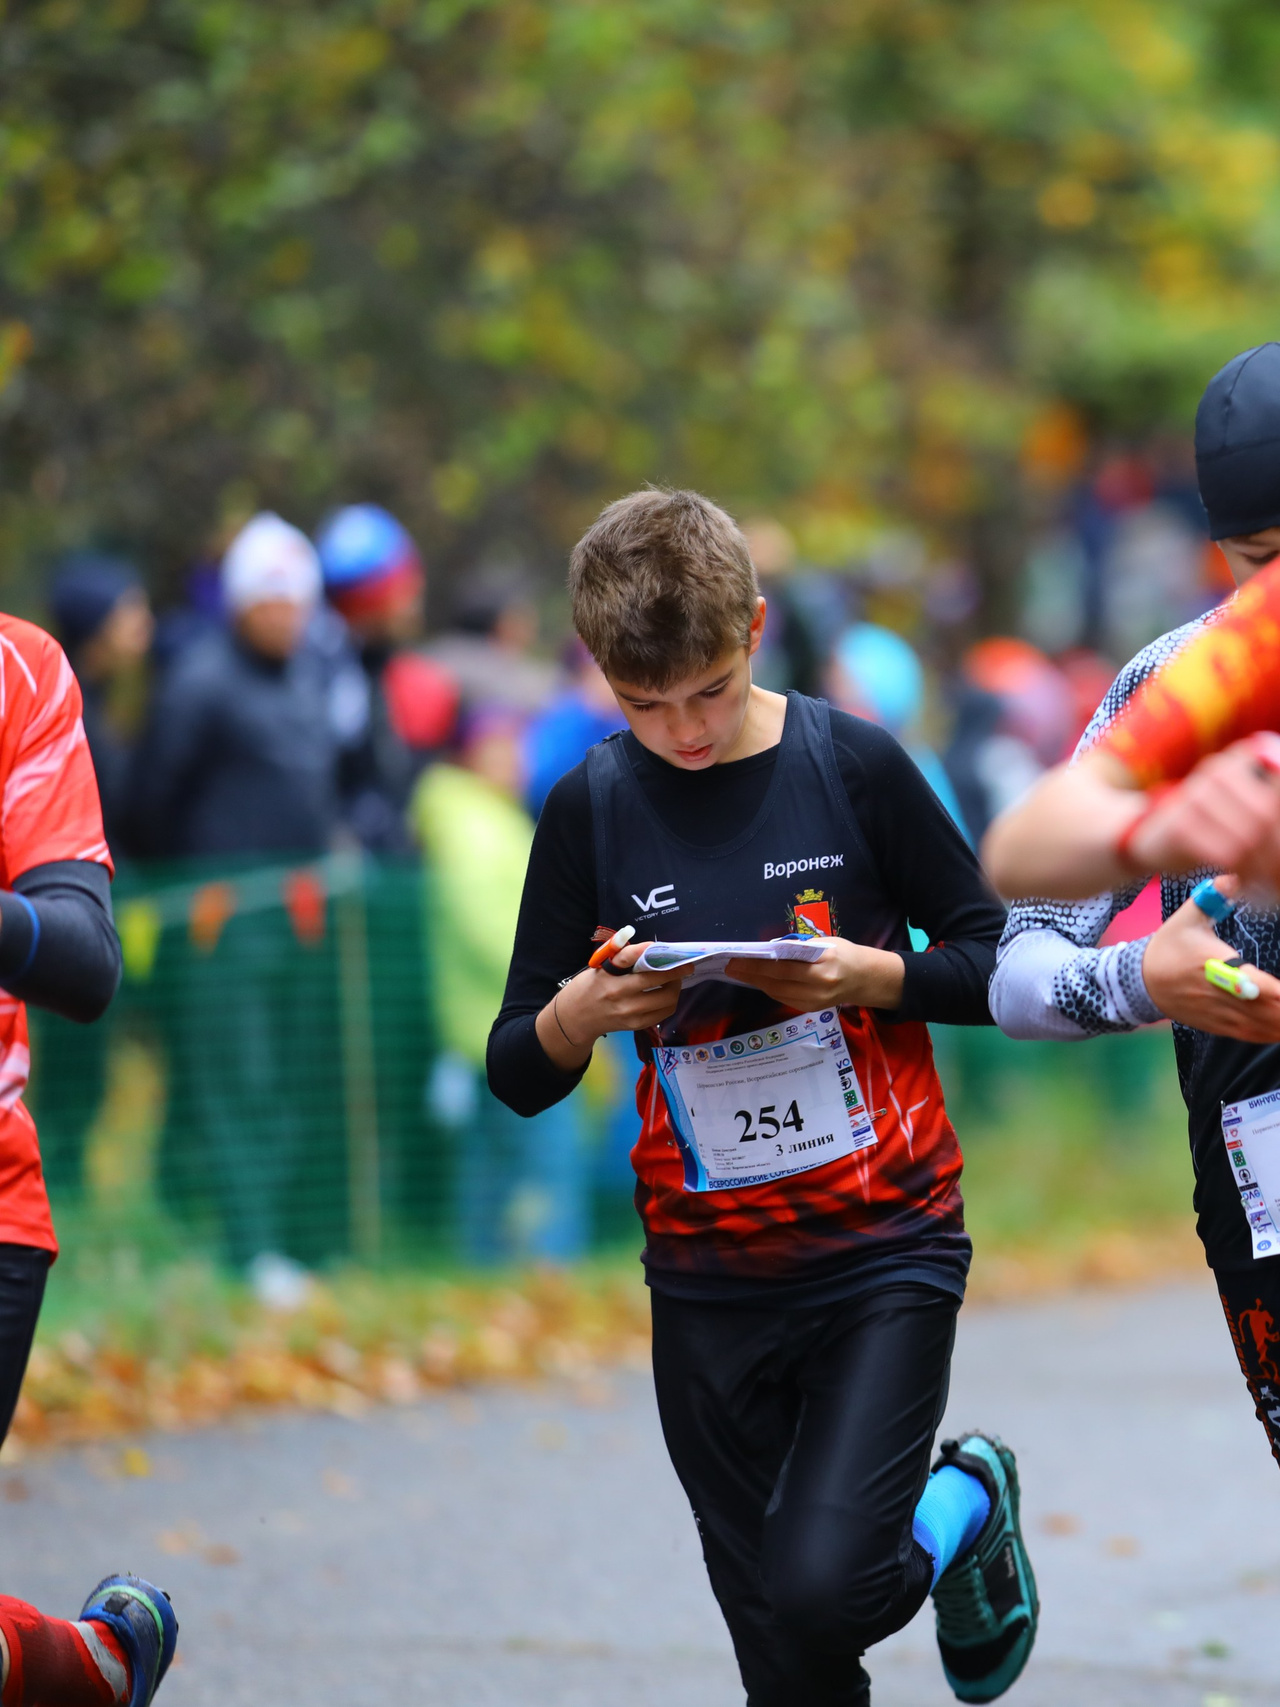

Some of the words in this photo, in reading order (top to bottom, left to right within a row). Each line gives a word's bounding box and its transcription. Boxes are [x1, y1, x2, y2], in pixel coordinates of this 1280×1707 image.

[763, 853, 844, 880] Воронеж
[631, 883, 677, 912] VC
[634, 911, 659, 922] VICTORY
[661, 905, 680, 915] CODE
[734, 1100, 805, 1143] 254
[775, 1144, 784, 1157] 3
[788, 1133, 835, 1154] линия
